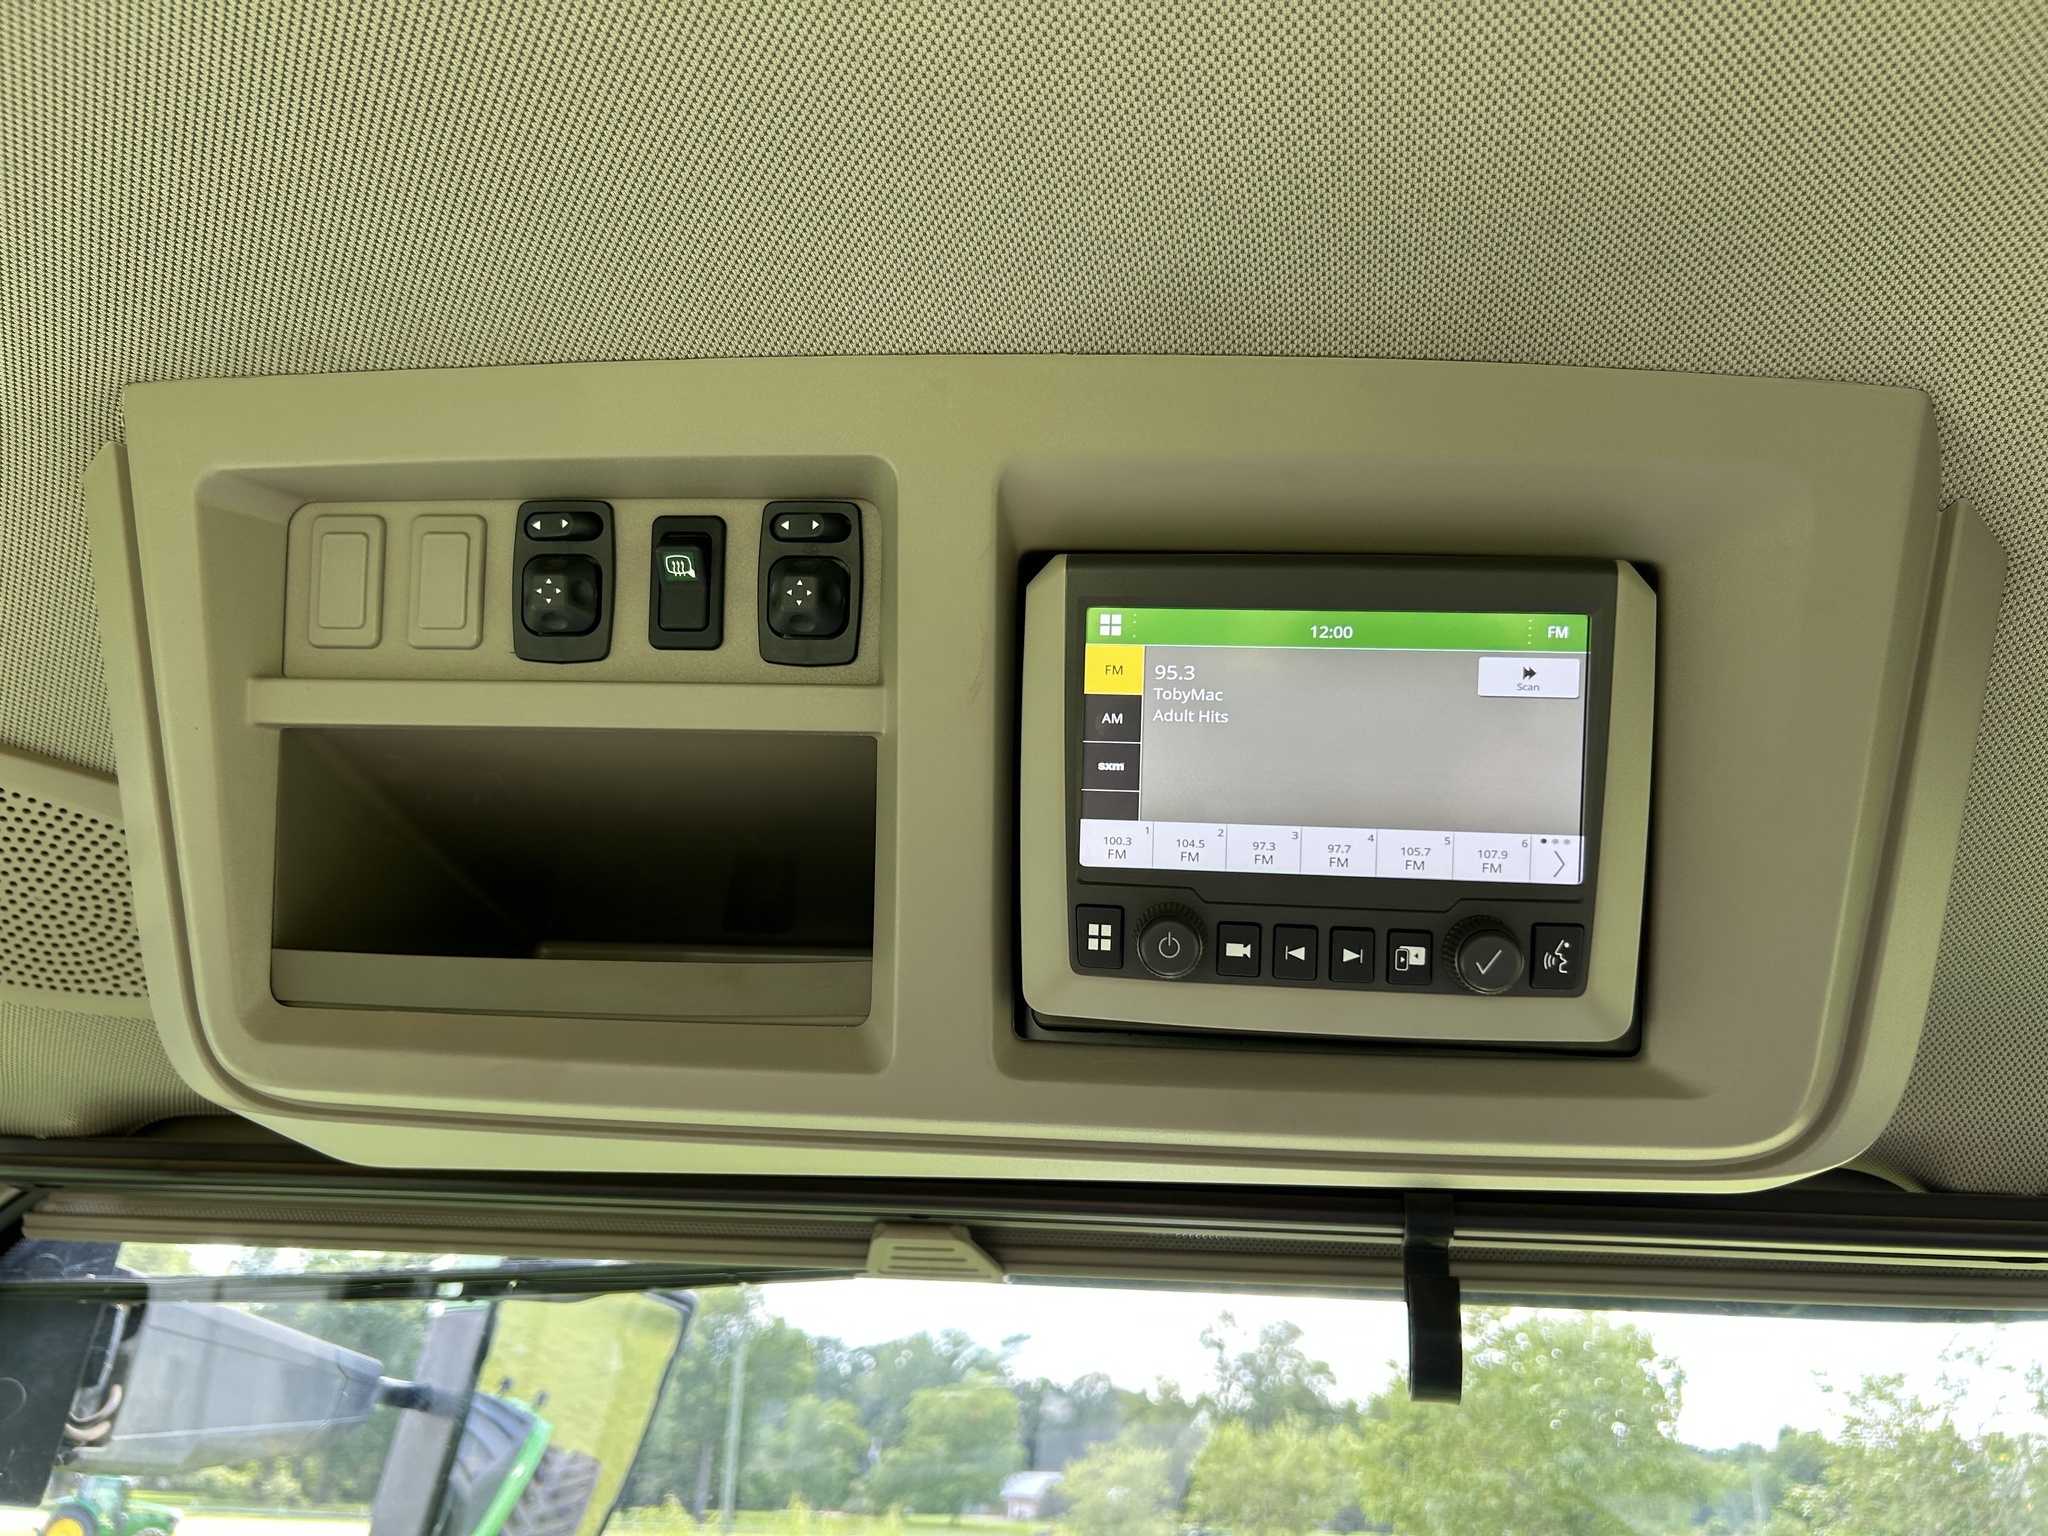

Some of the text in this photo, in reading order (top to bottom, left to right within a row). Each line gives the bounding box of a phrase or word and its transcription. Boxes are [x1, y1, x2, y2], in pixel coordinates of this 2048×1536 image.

[1310, 625, 1353, 639] 12:00
[1547, 625, 1569, 639] FM
[1105, 664, 1124, 676] FM
[1154, 664, 1196, 681] 95.3
[1516, 682, 1540, 692] Scan
[1153, 687, 1224, 704] TobyMac
[1101, 713, 1123, 724] AM
[1152, 709, 1229, 723] Adult Hits
[1097, 761, 1125, 771] sxm
[1144, 826, 1150, 835] 1
[1217, 828, 1225, 837] 2
[1291, 831, 1299, 840] 3
[1103, 836, 1132, 846] 100.3
[1176, 838, 1205, 849] 104.5
[1367, 833, 1375, 843] 4
[1443, 836, 1451, 846] 5
[1521, 839, 1529, 848] 6
[1252, 841, 1276, 851] 97.3
[1327, 844, 1351, 854] 97.7
[1400, 846, 1431, 857] 105.7
[1107, 849, 1127, 860] FM
[1180, 851, 1200, 863] FM
[1254, 854, 1274, 865] FM
[1477, 849, 1508, 860] 107.9
[1329, 857, 1349, 868] FM
[1405, 859, 1425, 871] FM
[1482, 862, 1502, 874] FM
